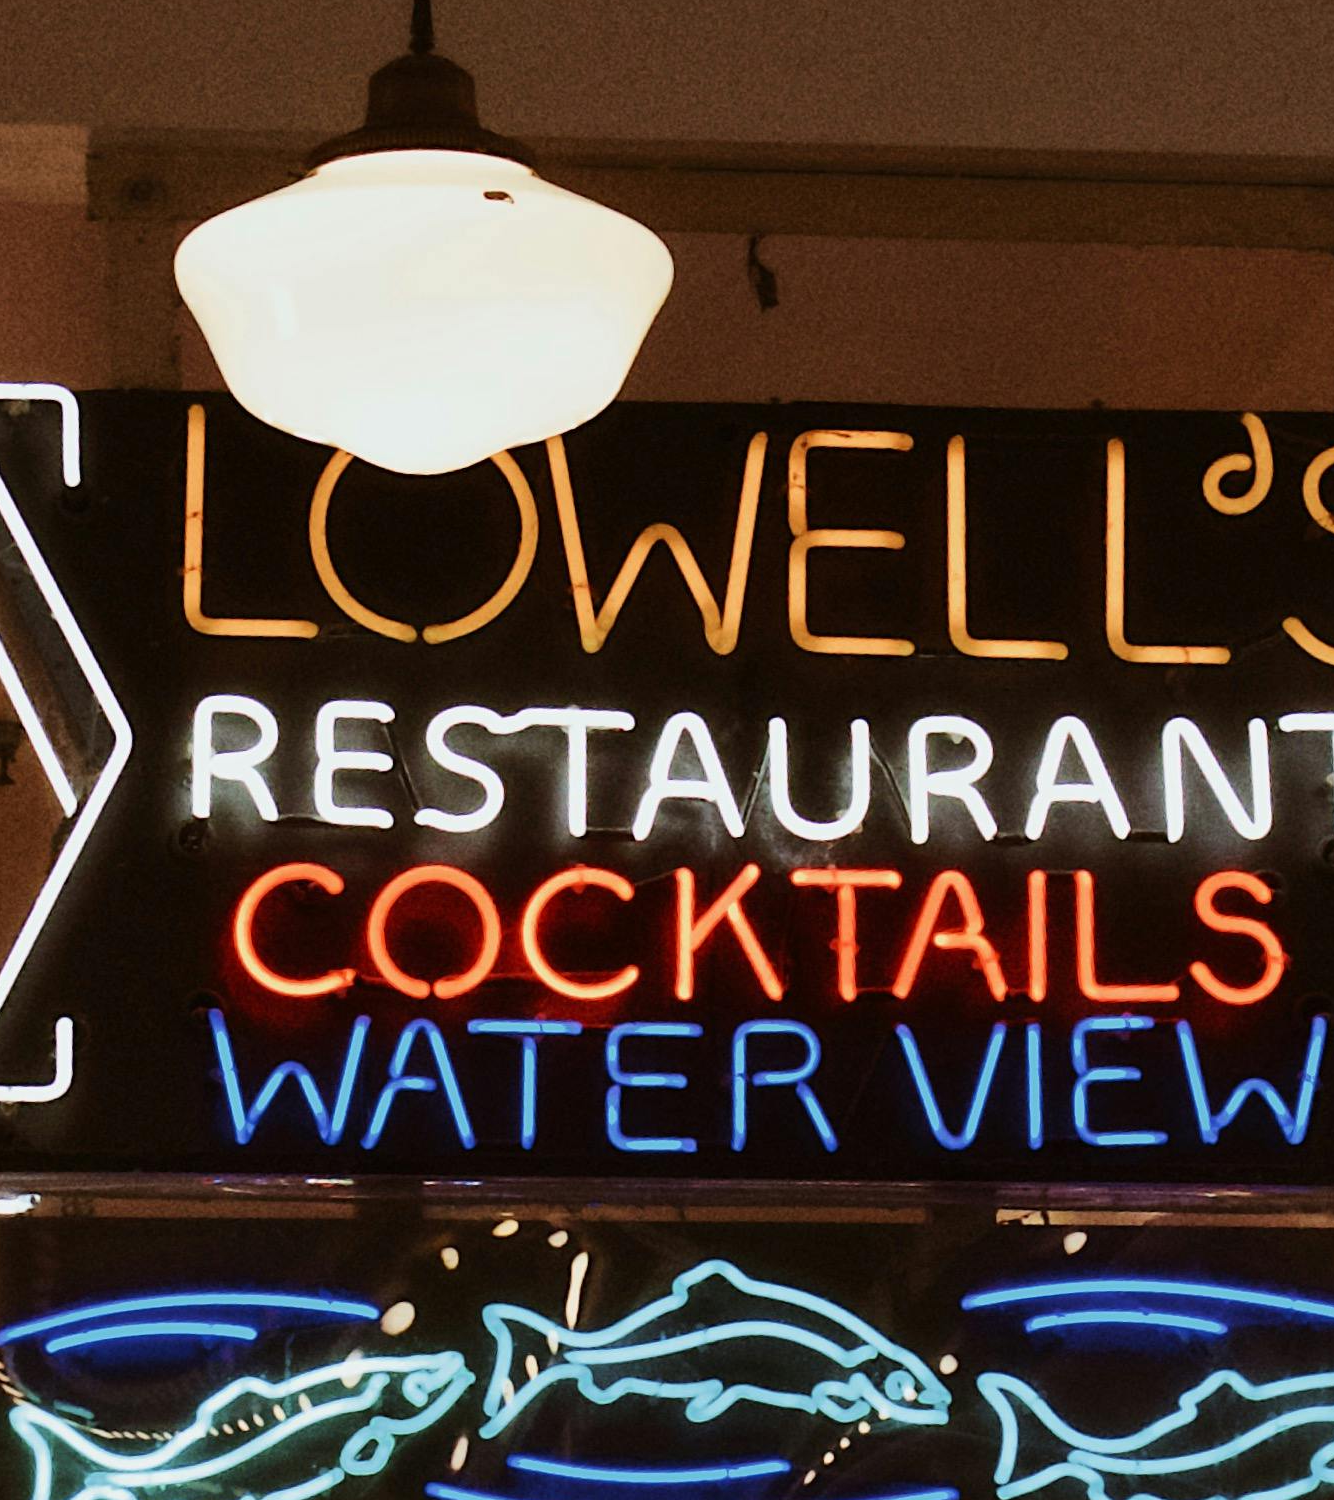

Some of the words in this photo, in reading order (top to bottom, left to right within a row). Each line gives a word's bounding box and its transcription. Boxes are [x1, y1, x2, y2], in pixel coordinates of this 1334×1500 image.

[232, 862, 1289, 1004] COCKTAILS
[209, 1007, 839, 1153] WATER
[896, 1012, 1331, 1153] VIEW
